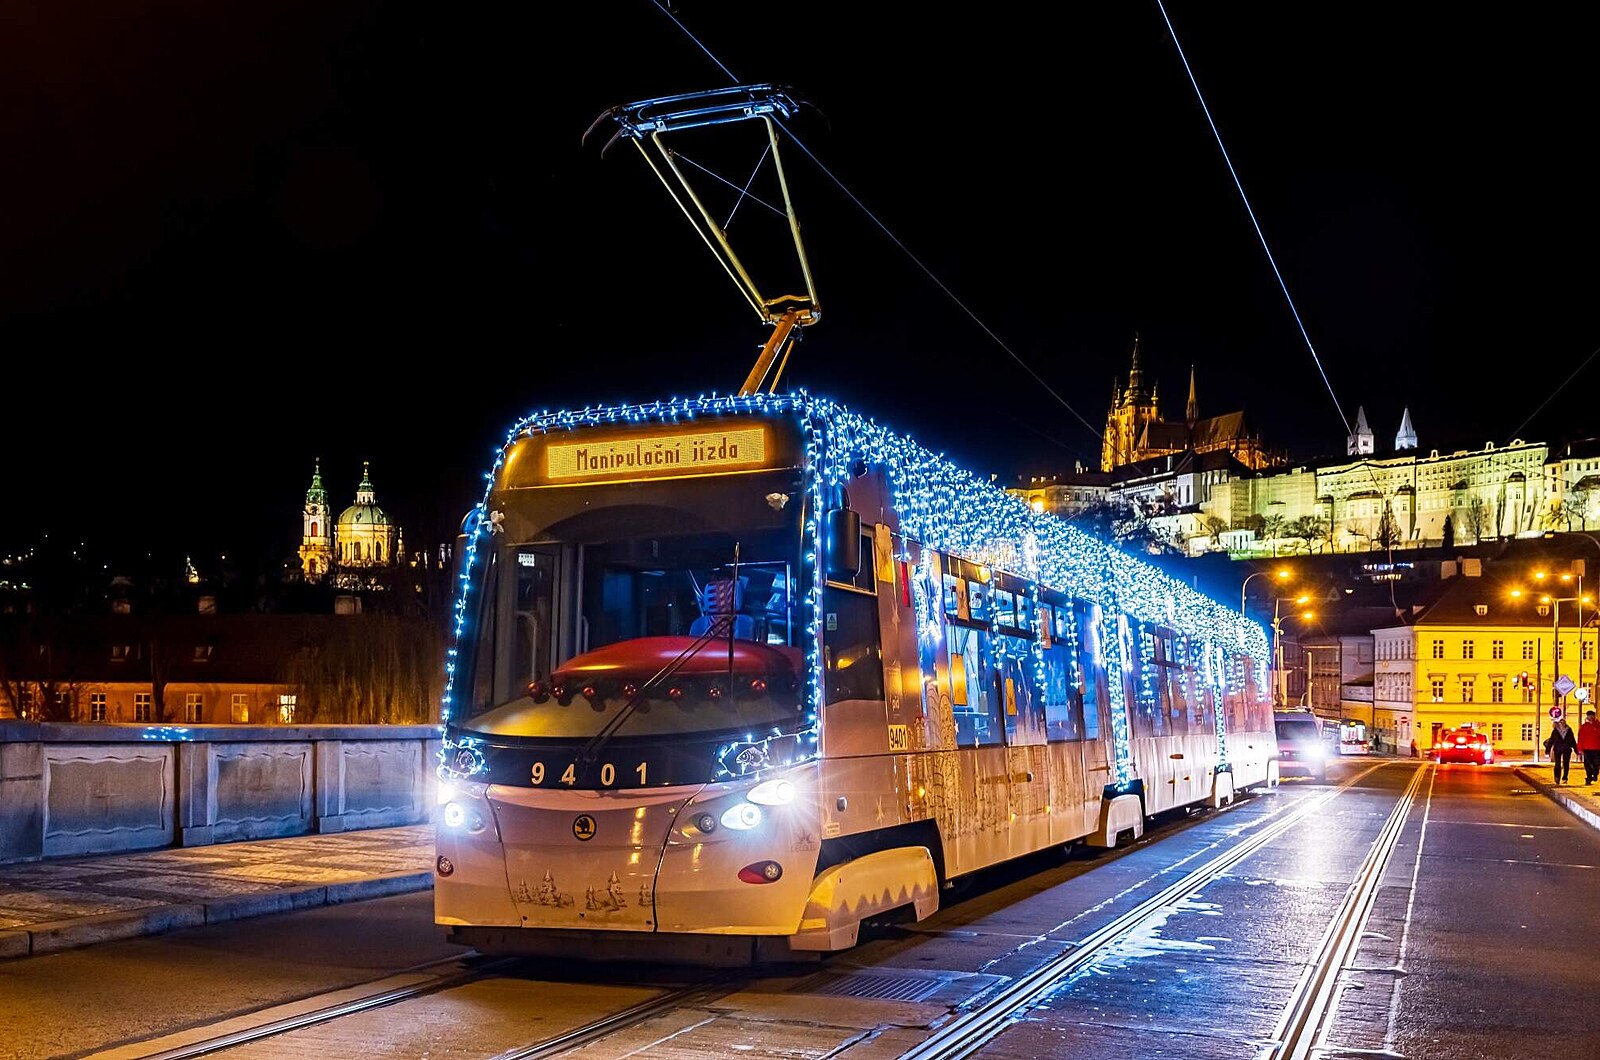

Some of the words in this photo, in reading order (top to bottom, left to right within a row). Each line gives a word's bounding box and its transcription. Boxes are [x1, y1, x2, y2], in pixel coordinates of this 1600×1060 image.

[576, 443, 680, 471] Manipulační
[692, 437, 738, 462] jízda
[890, 728, 907, 748] 9401
